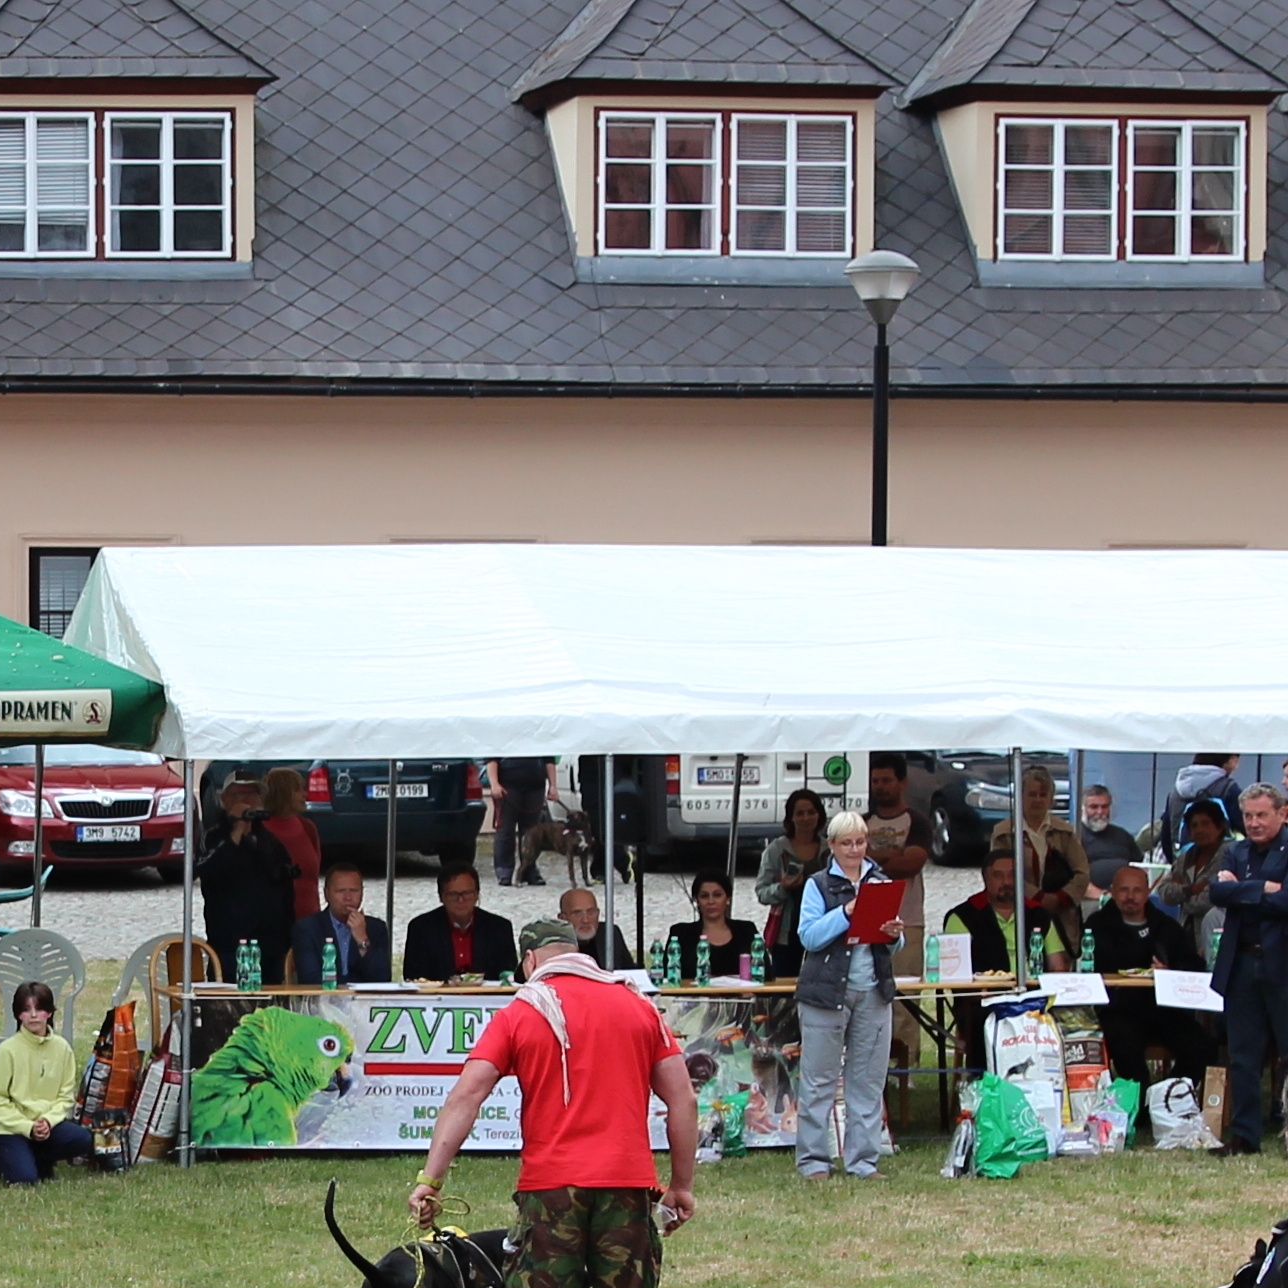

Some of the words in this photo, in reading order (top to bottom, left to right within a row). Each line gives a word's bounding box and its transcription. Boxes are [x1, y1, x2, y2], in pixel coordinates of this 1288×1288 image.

[687, 800, 711, 811] 605
[745, 799, 768, 810] 376
[111, 826, 137, 838] 5742
[365, 1085, 392, 1097] ZOO
[396, 1085, 444, 1097] PRODEJ
